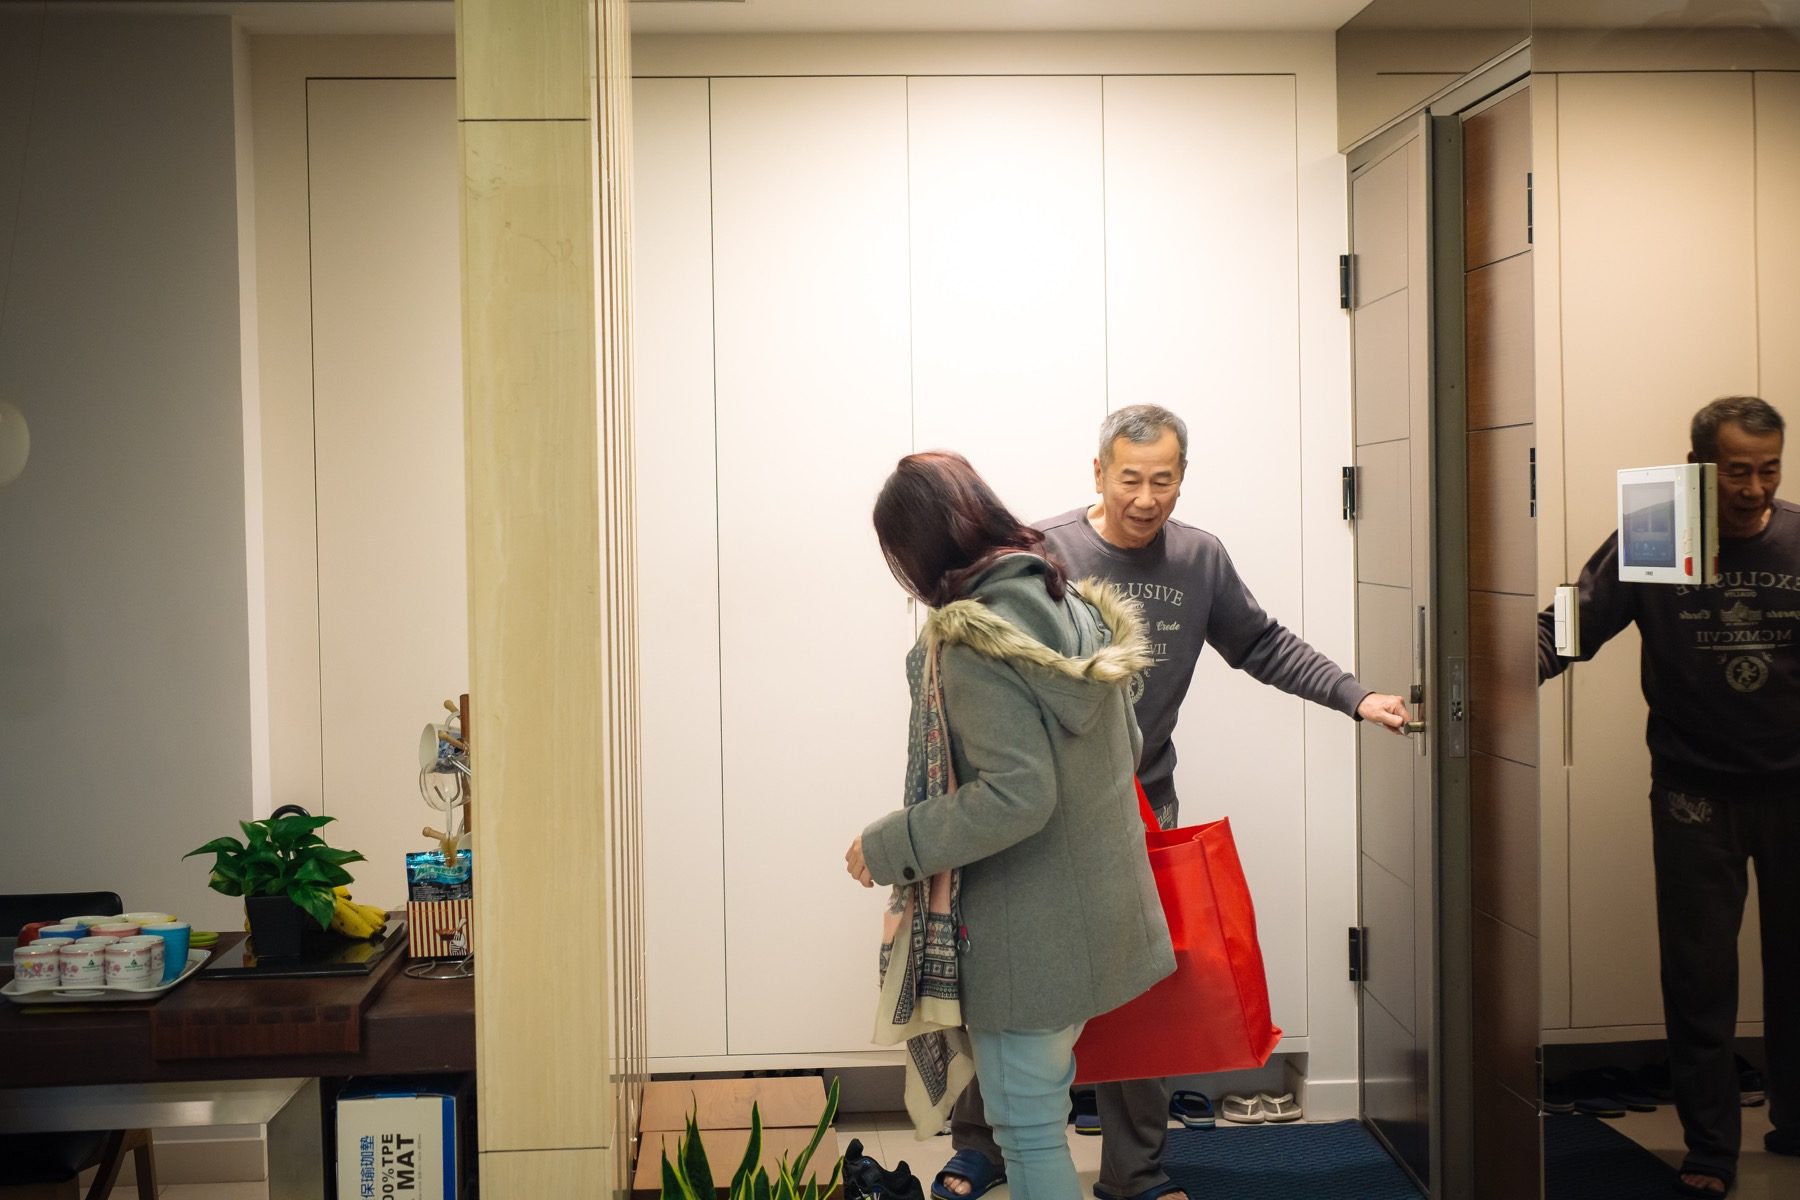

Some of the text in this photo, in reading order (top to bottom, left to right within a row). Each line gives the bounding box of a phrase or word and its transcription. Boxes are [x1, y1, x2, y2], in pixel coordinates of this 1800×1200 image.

[1156, 620, 1180, 632] Crede
[360, 1135, 375, 1200] 保瑜珈墊
[396, 1133, 415, 1190] MAT
